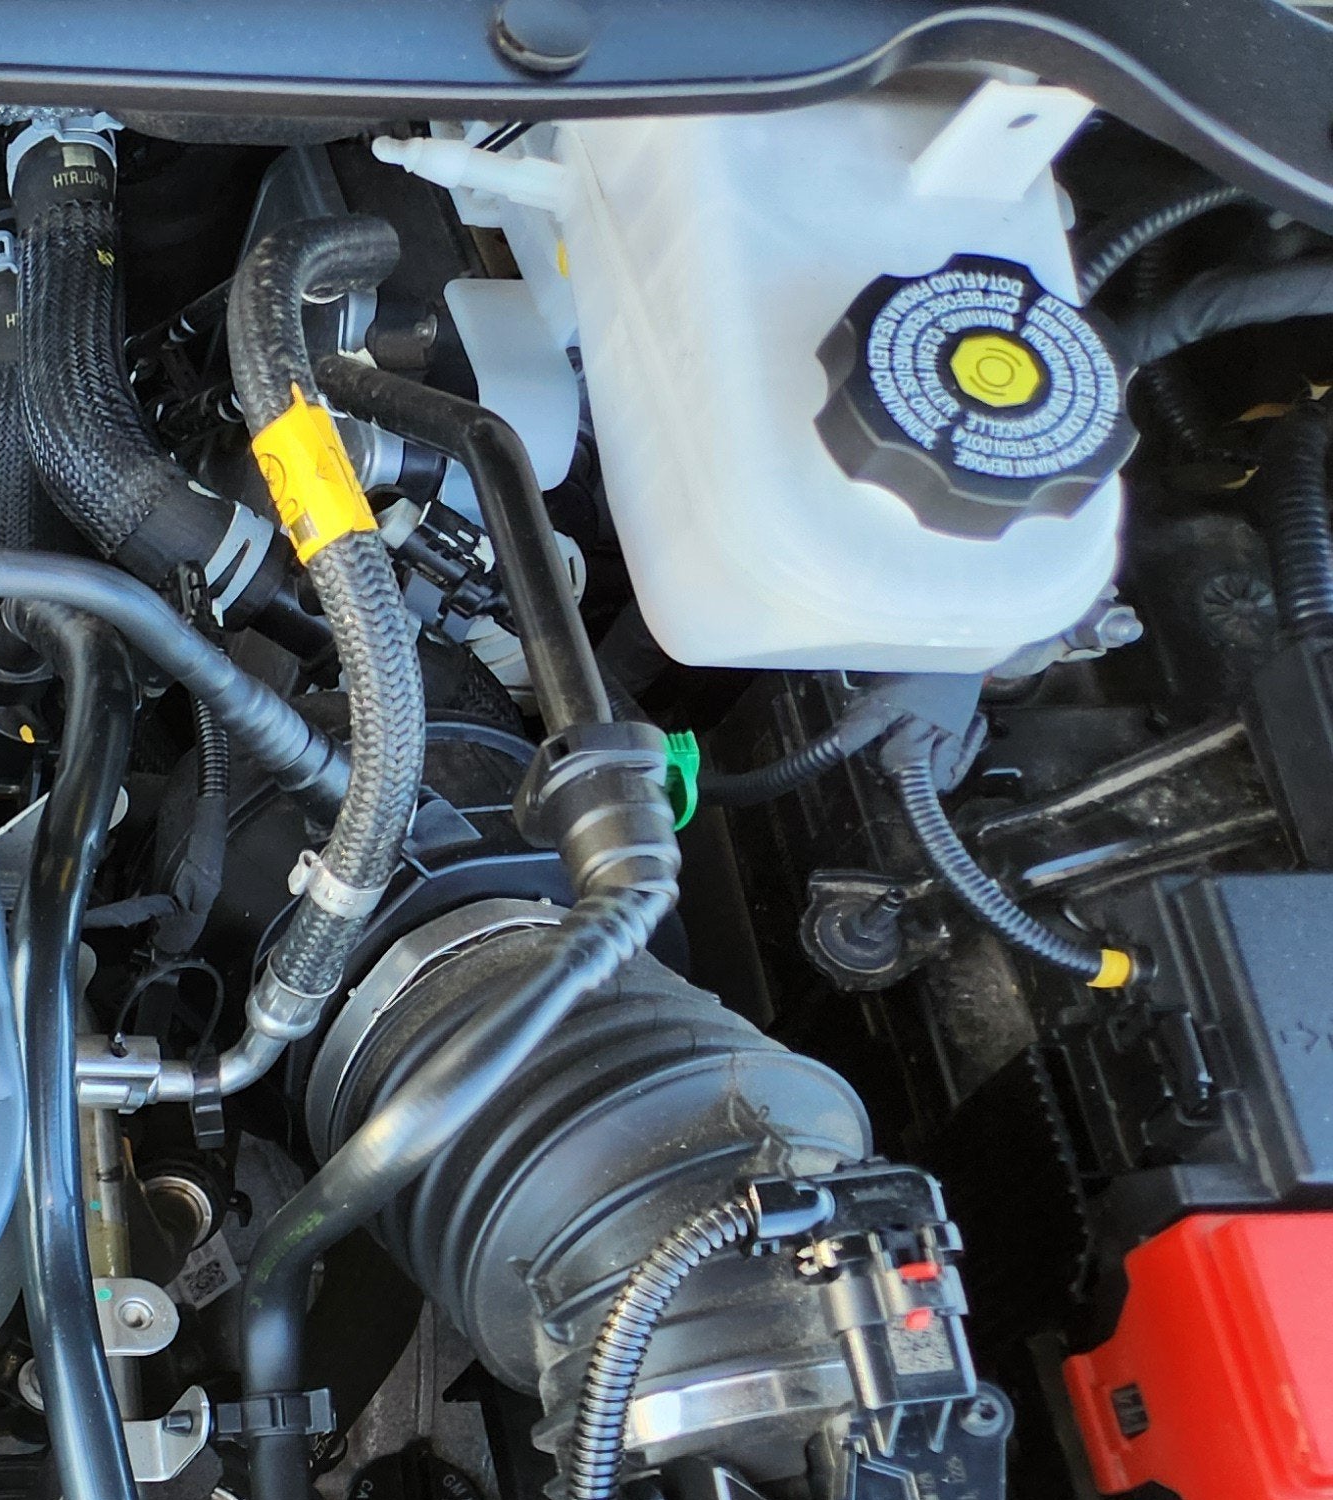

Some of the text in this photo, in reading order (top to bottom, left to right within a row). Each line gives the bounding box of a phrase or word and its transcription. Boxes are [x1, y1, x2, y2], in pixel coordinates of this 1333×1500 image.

[924, 269, 977, 294] FLUID
[921, 291, 985, 317] BEFORE
[983, 292, 1021, 315] CAP
[864, 313, 901, 369] SEALED
[894, 369, 921, 397] USE
[905, 393, 951, 434] ONLY
[443, 1474, 467, 1496] GM
